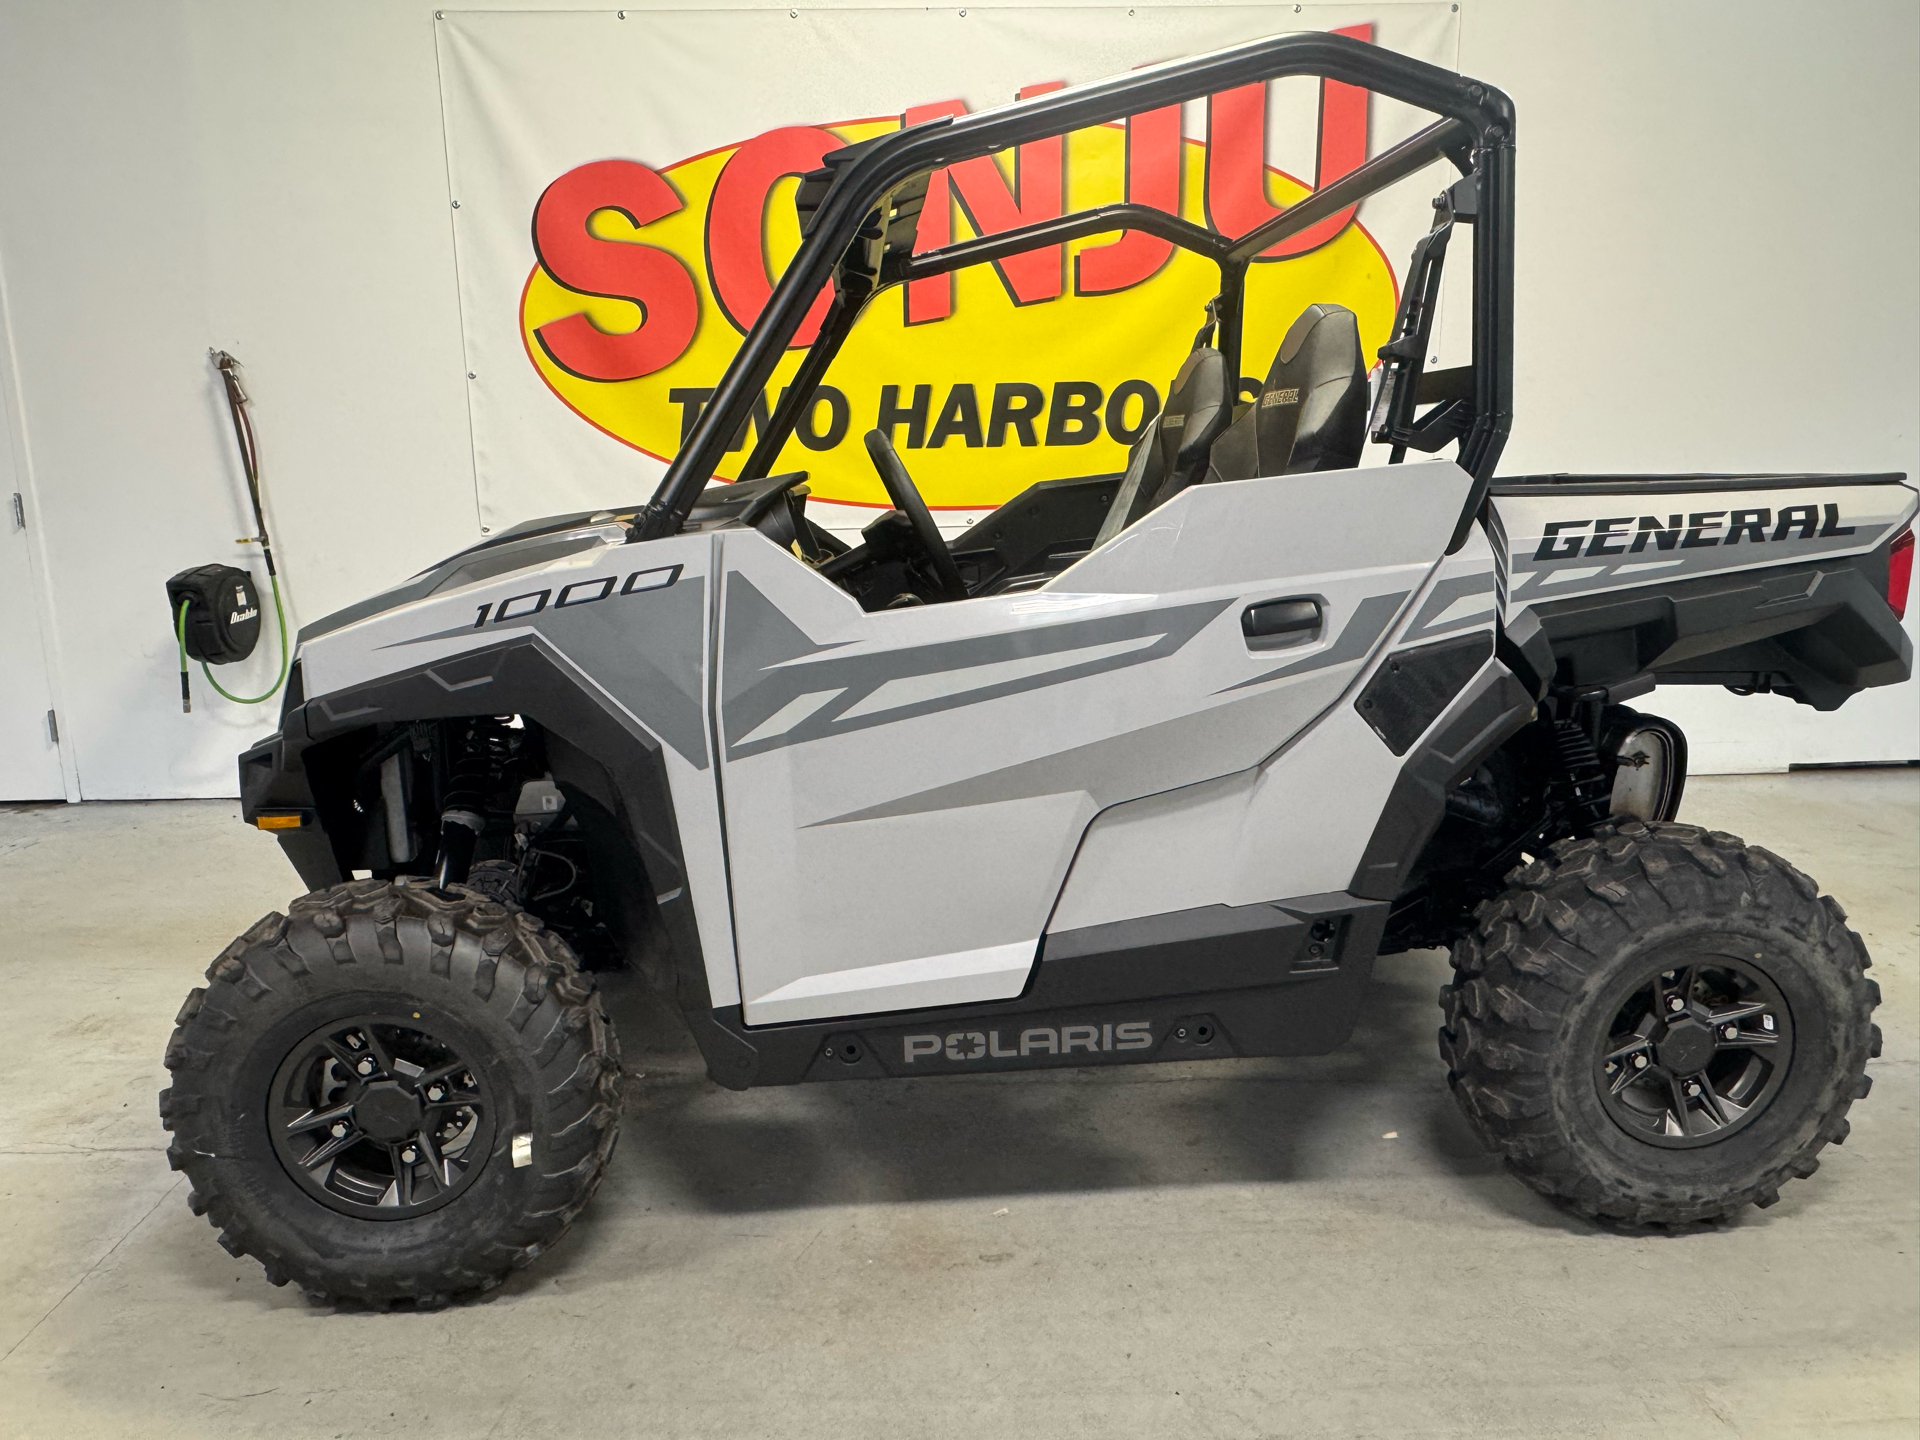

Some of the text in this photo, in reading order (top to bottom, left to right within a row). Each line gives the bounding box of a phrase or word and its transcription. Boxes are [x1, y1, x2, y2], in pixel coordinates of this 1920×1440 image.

[533, 24, 1376, 381] SONJU
[875, 377, 1264, 451] HARBO
[1533, 503, 1855, 561] GENERAL
[474, 564, 684, 628] 1000
[903, 1022, 1152, 1063] POLARIS
